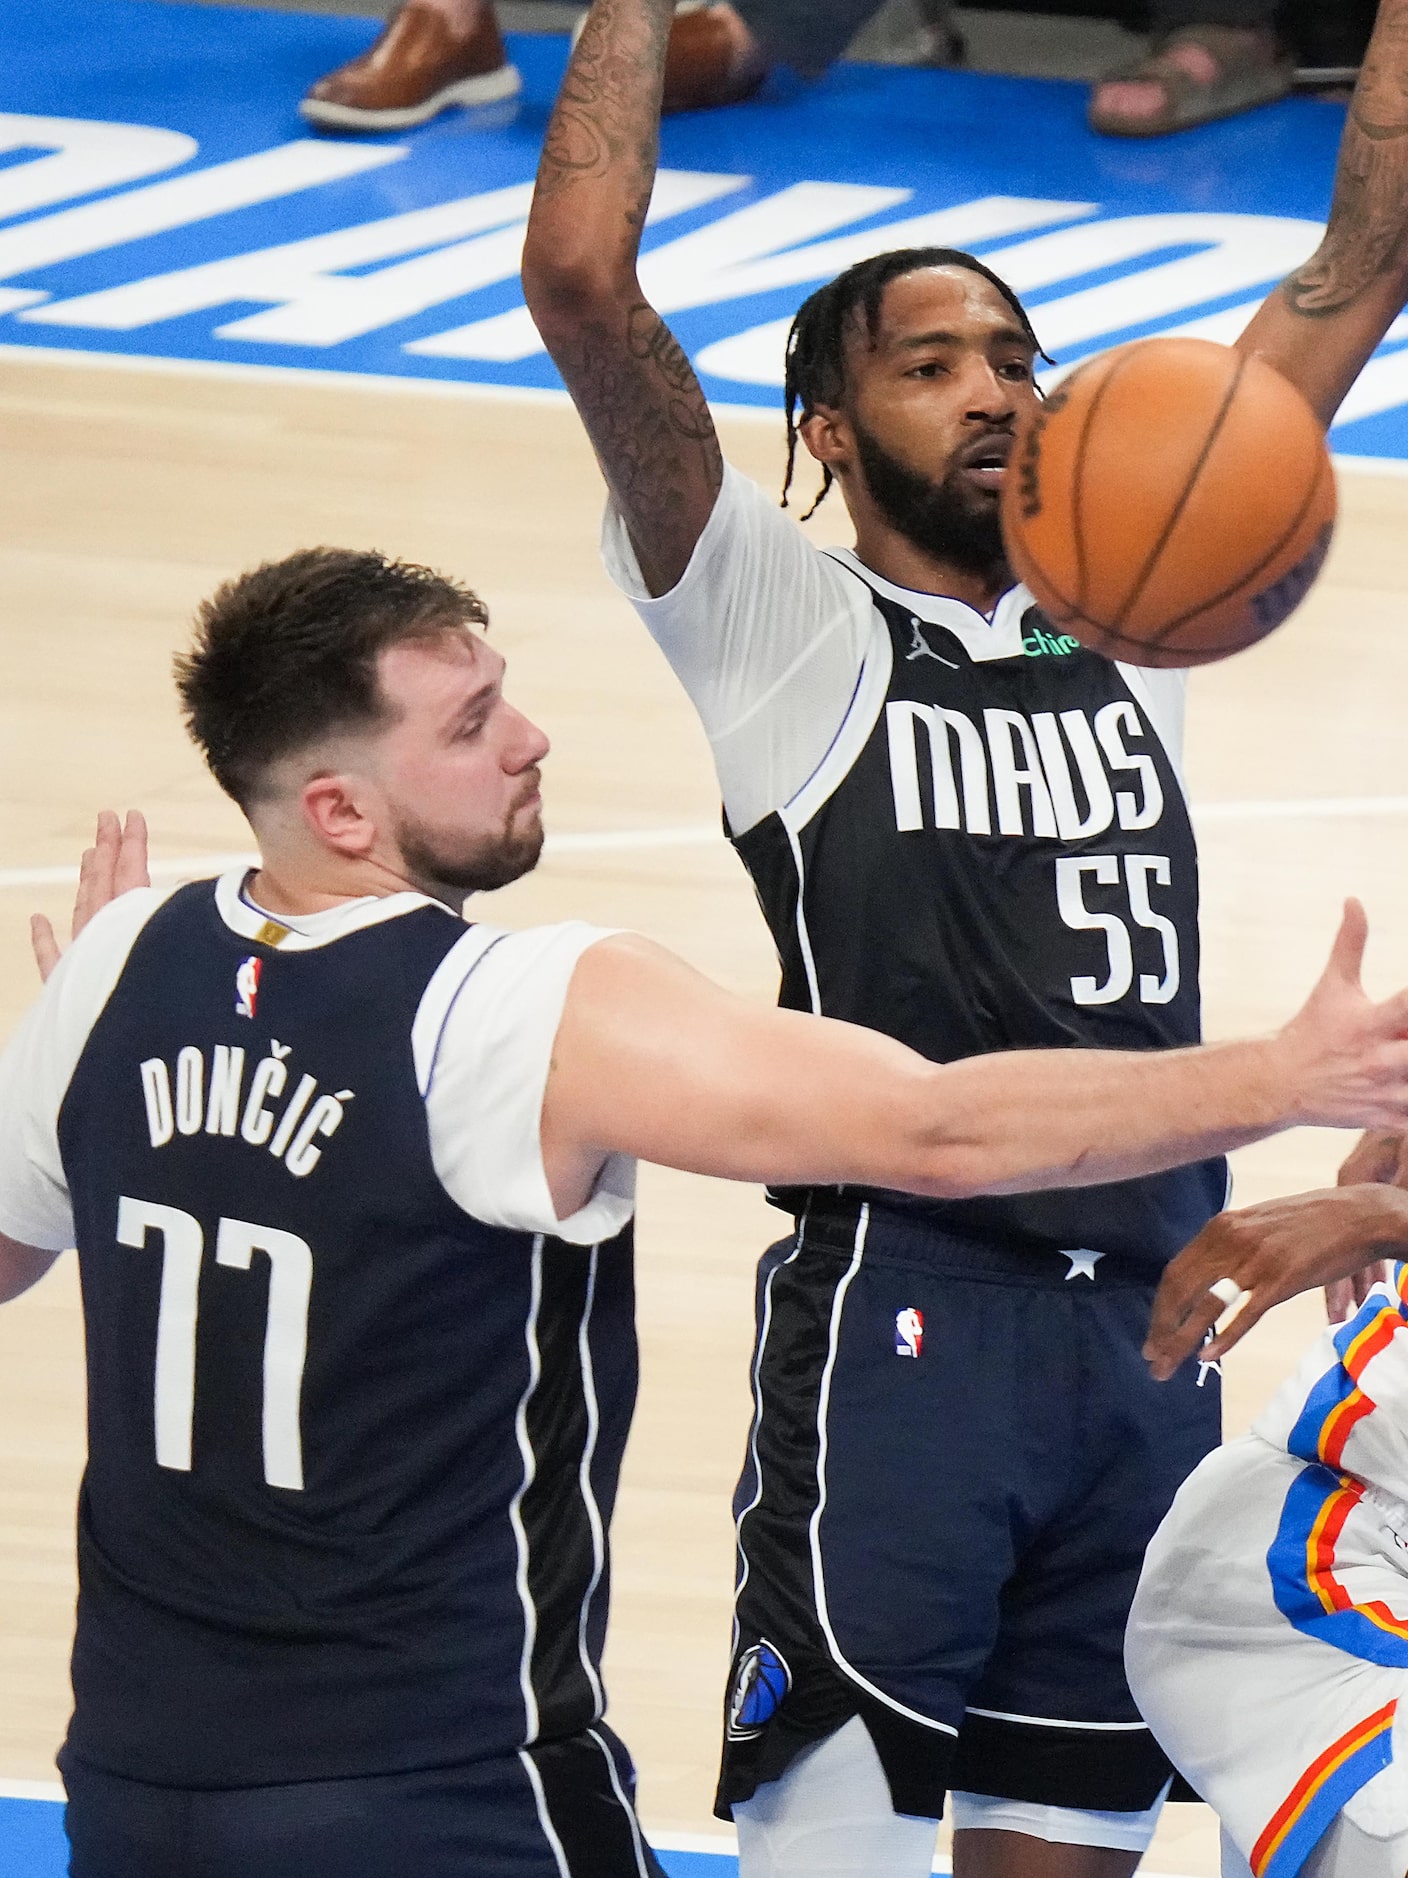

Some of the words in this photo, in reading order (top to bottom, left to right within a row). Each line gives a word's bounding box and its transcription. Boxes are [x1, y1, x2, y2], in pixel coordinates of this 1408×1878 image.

[1055, 853, 1181, 1005] 55
[139, 1038, 355, 1178] DONČIĆ
[116, 1196, 315, 1491] 77
